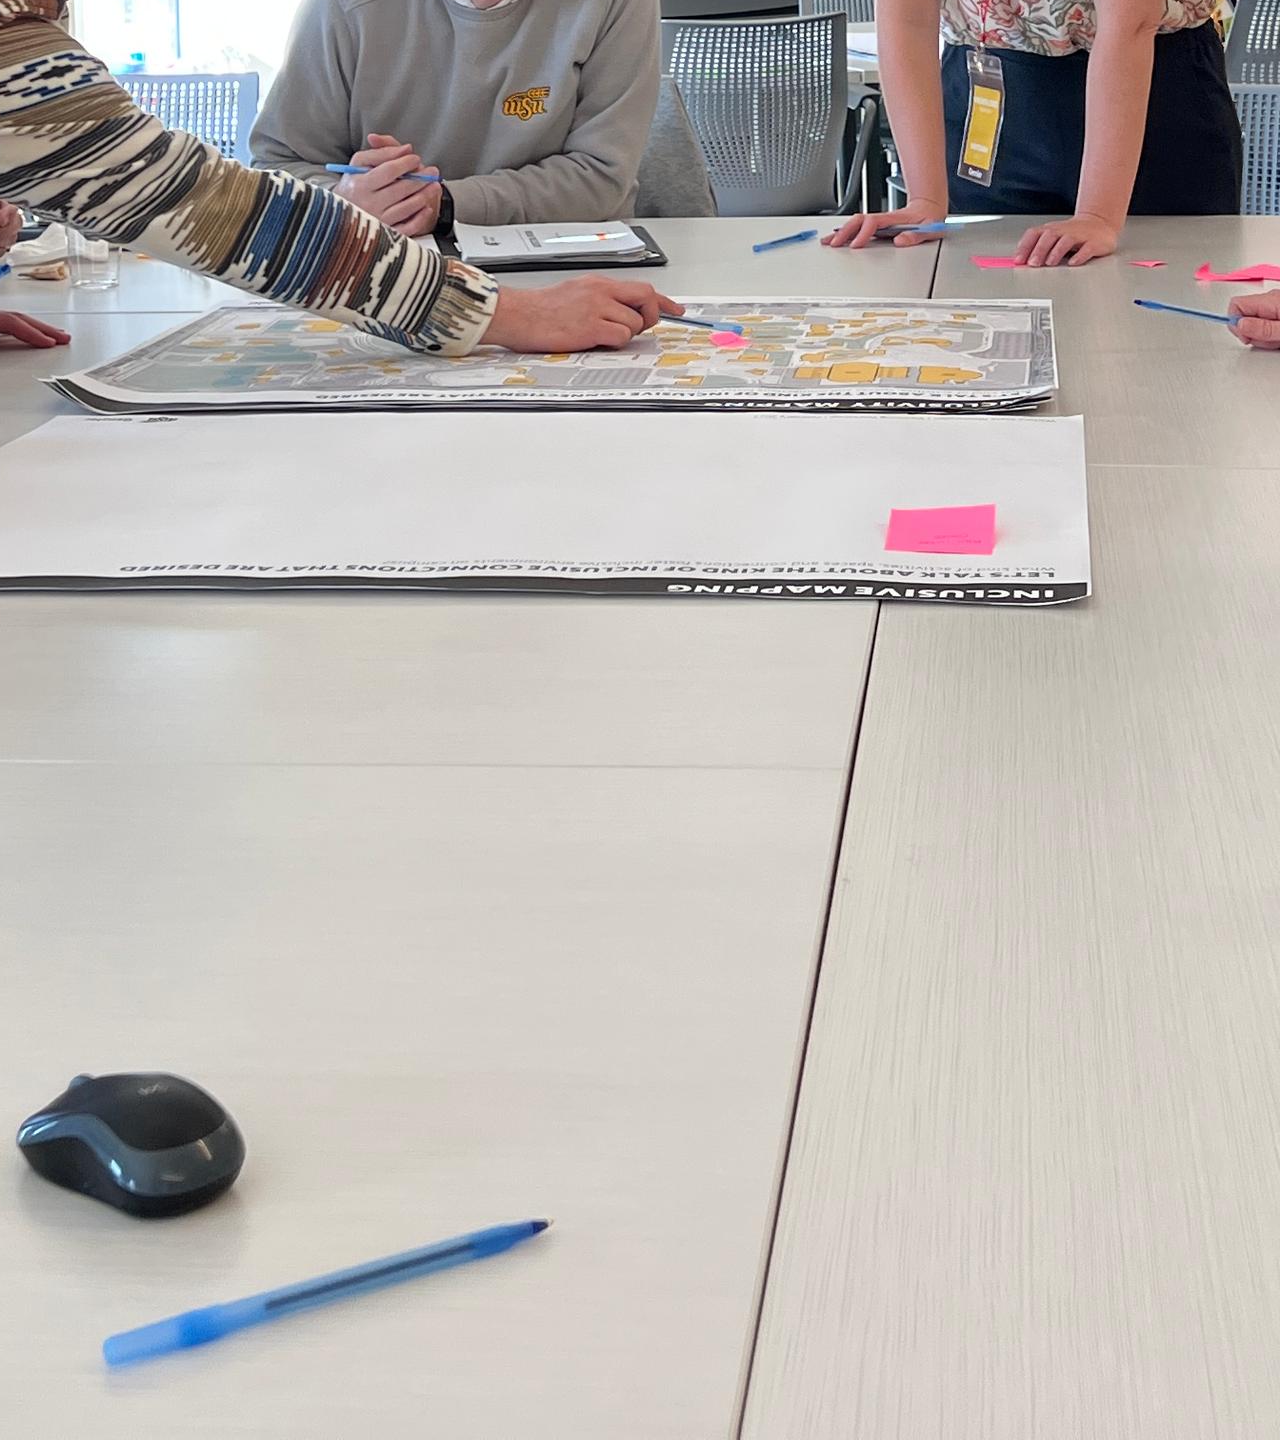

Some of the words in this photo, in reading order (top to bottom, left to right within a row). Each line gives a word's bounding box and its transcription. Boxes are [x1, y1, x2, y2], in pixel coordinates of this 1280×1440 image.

[119, 564, 221, 572] DESIRED
[224, 564, 274, 572] ARE
[345, 564, 524, 573] CONNECTIONS
[527, 565, 659, 573] INCLUSIVE
[823, 567, 915, 577] ABOUT
[666, 584, 848, 595] MAPPING
[854, 586, 1055, 600] INCLUSIVE
